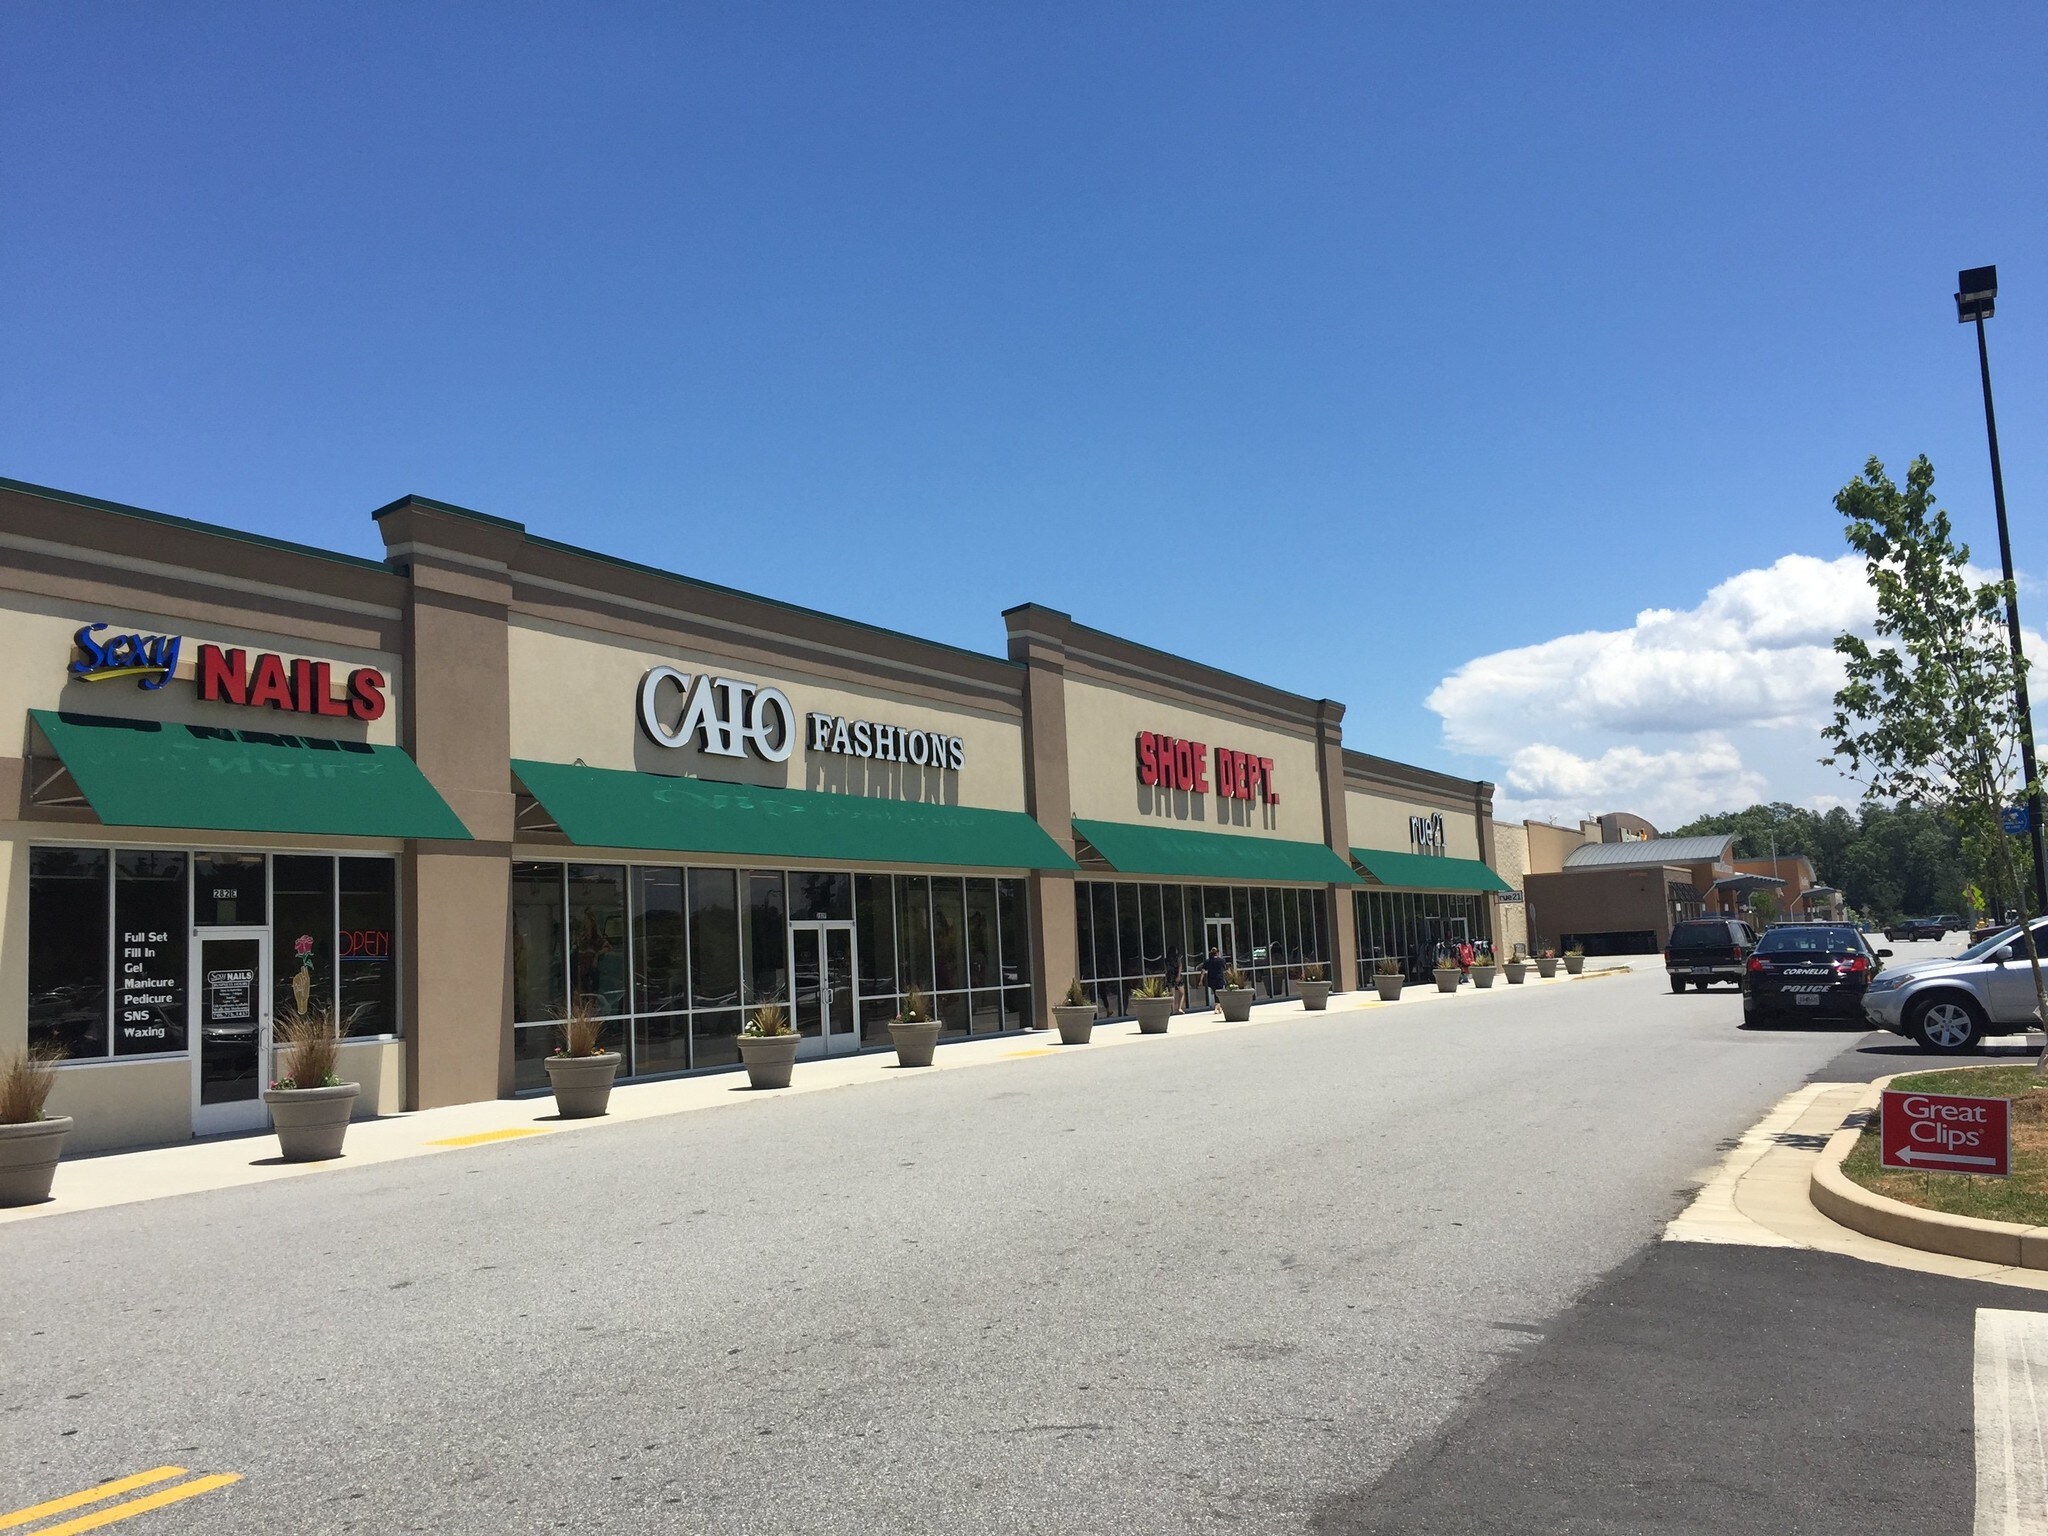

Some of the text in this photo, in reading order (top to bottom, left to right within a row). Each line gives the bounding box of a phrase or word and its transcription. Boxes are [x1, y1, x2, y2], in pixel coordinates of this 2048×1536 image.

[67, 622, 386, 721] Sexy NAILS
[635, 665, 966, 771] CATO FASHIONS
[1135, 730, 1280, 805] SHOE DEPT.
[1409, 812, 1447, 847] rue21
[1500, 893, 1521, 901] rue21
[124, 932, 168, 943] Full Set
[339, 930, 389, 956] OPEN
[124, 947, 156, 958] Fill In
[124, 962, 143, 973] Gel
[227, 972, 252, 981] NAILS
[124, 978, 175, 989] Manicure
[1780, 985, 1832, 993] POLICE
[124, 994, 173, 1005] Pedicure
[123, 1010, 150, 1022] SNS
[124, 1026, 165, 1039] Waxing
[1902, 1096, 1988, 1123] Great
[1909, 1121, 1980, 1151] Clips
